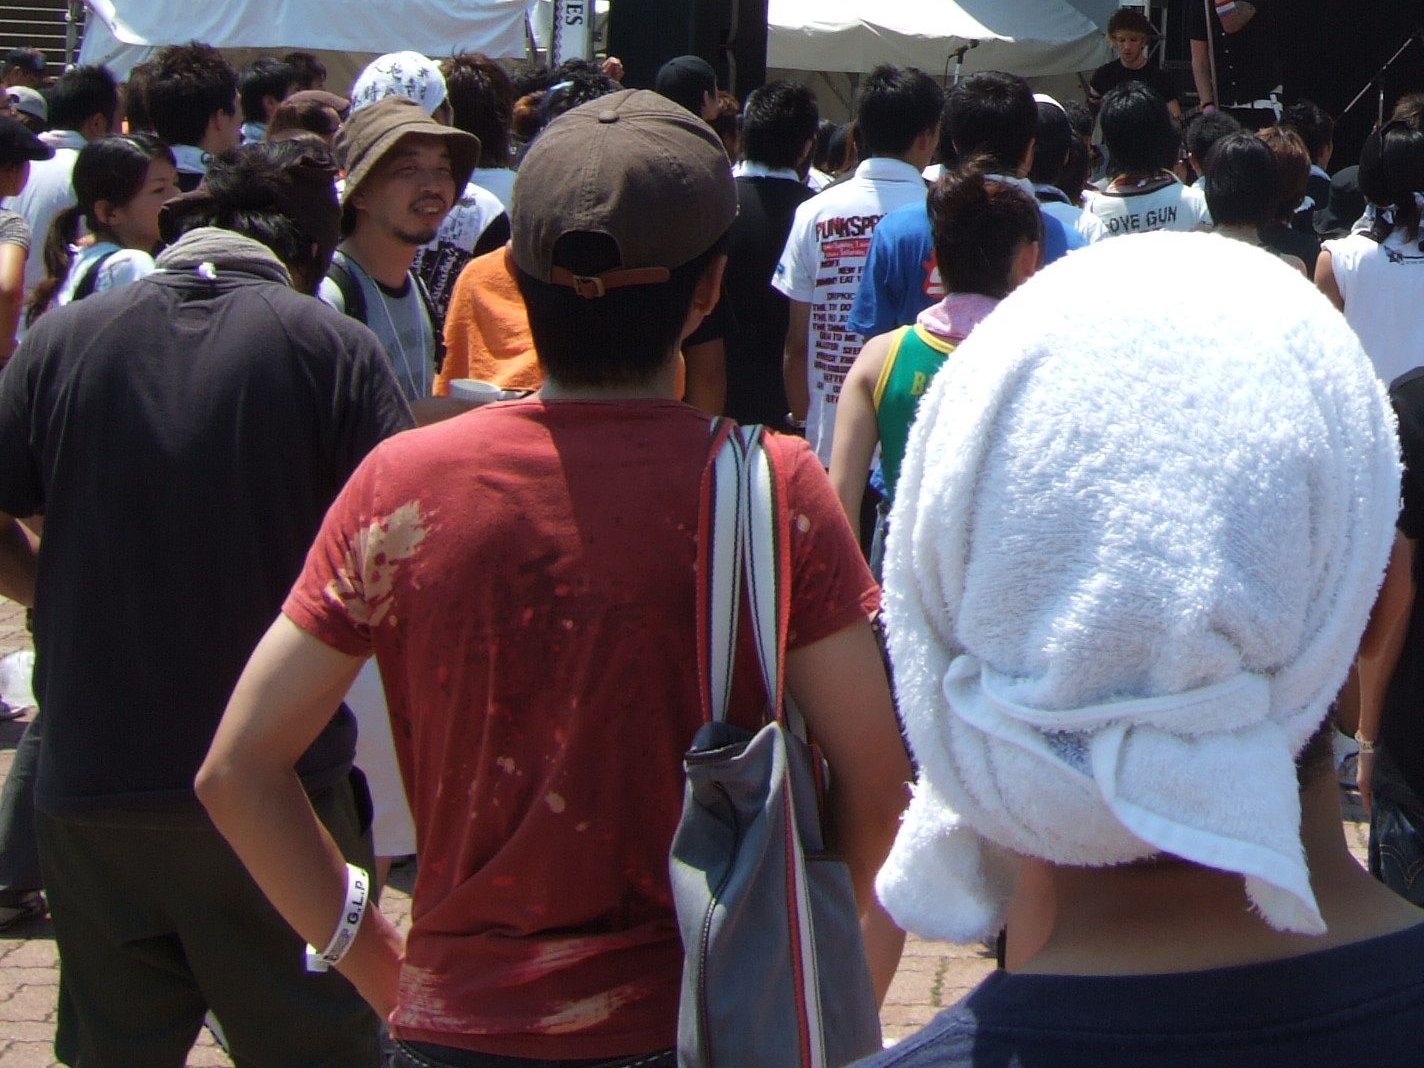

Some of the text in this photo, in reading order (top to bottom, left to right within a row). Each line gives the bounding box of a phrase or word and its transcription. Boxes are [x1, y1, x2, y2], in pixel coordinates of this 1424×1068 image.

[815, 214, 888, 243] PUNKSPR
[1106, 206, 1178, 233] OVE GUN
